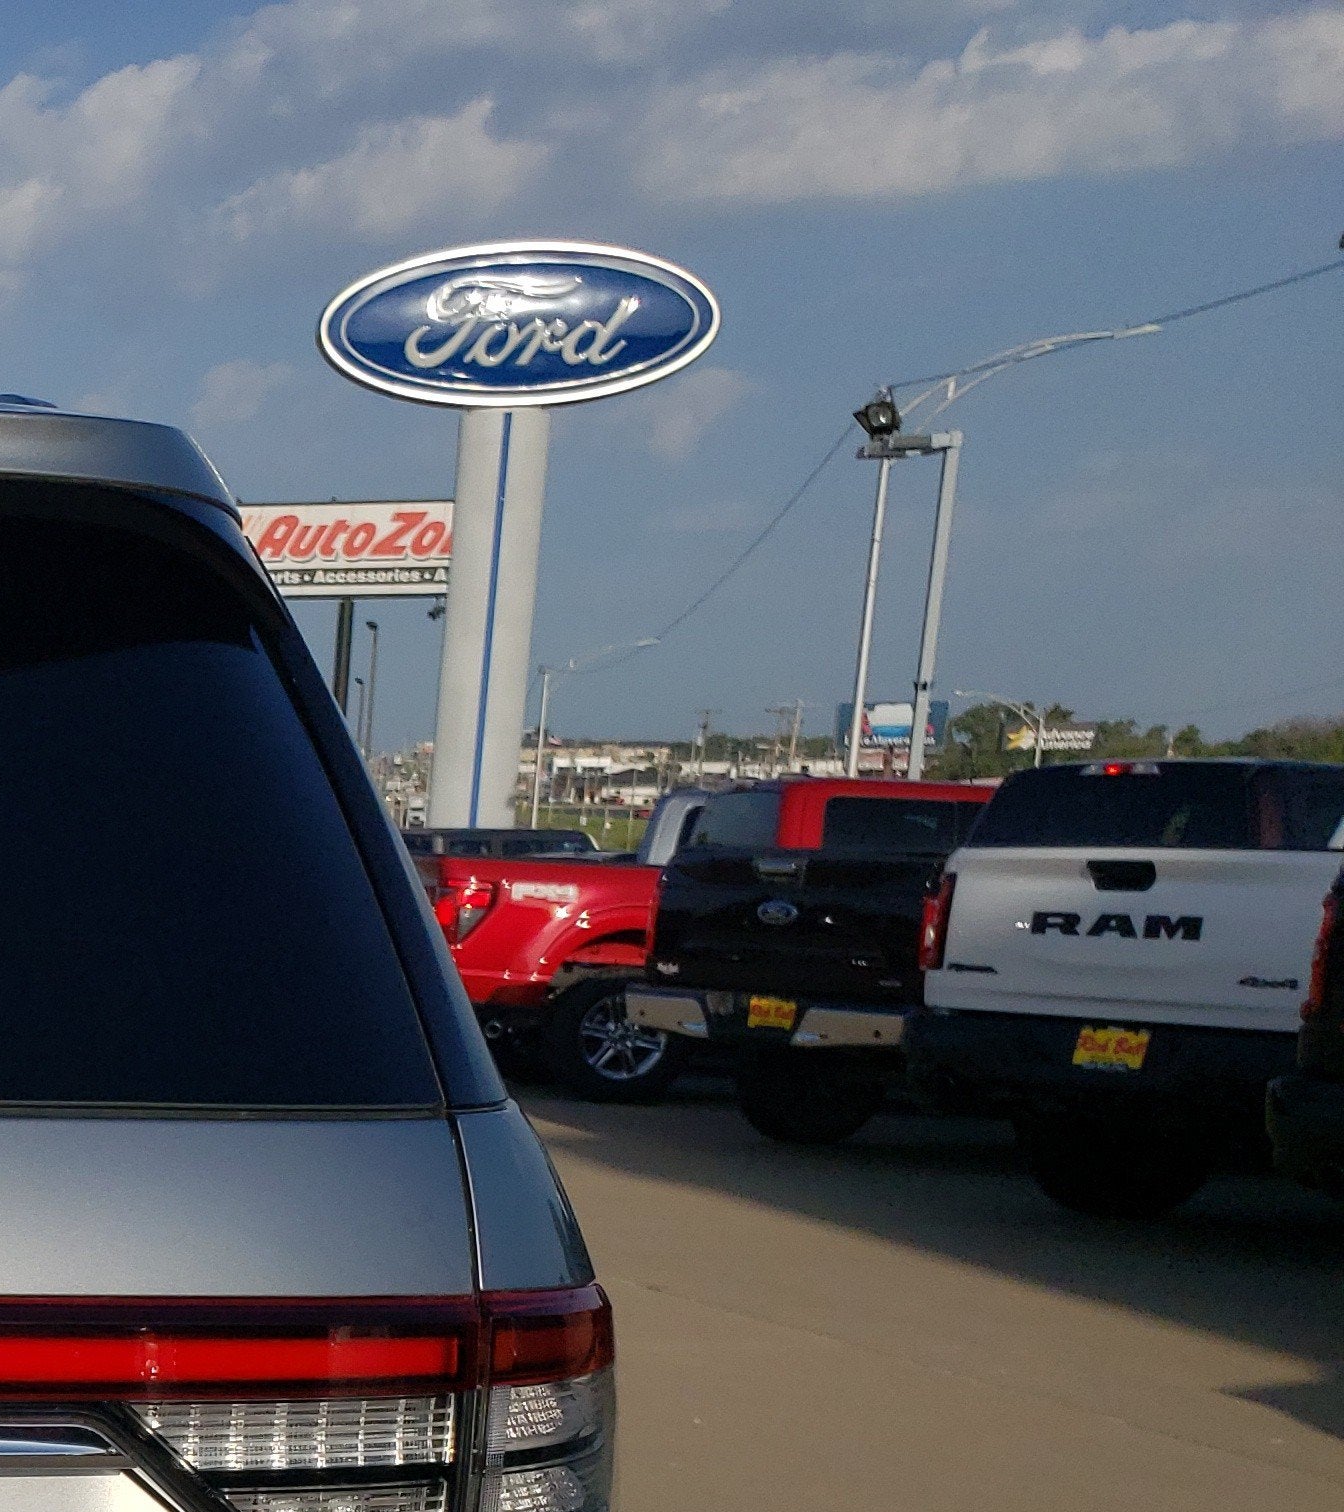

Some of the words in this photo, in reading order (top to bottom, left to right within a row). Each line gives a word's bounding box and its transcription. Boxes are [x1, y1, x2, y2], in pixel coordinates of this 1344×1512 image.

[405, 275, 641, 369] Ford
[312, 568, 421, 585] Accessories
[1031, 911, 1204, 941] RAM
